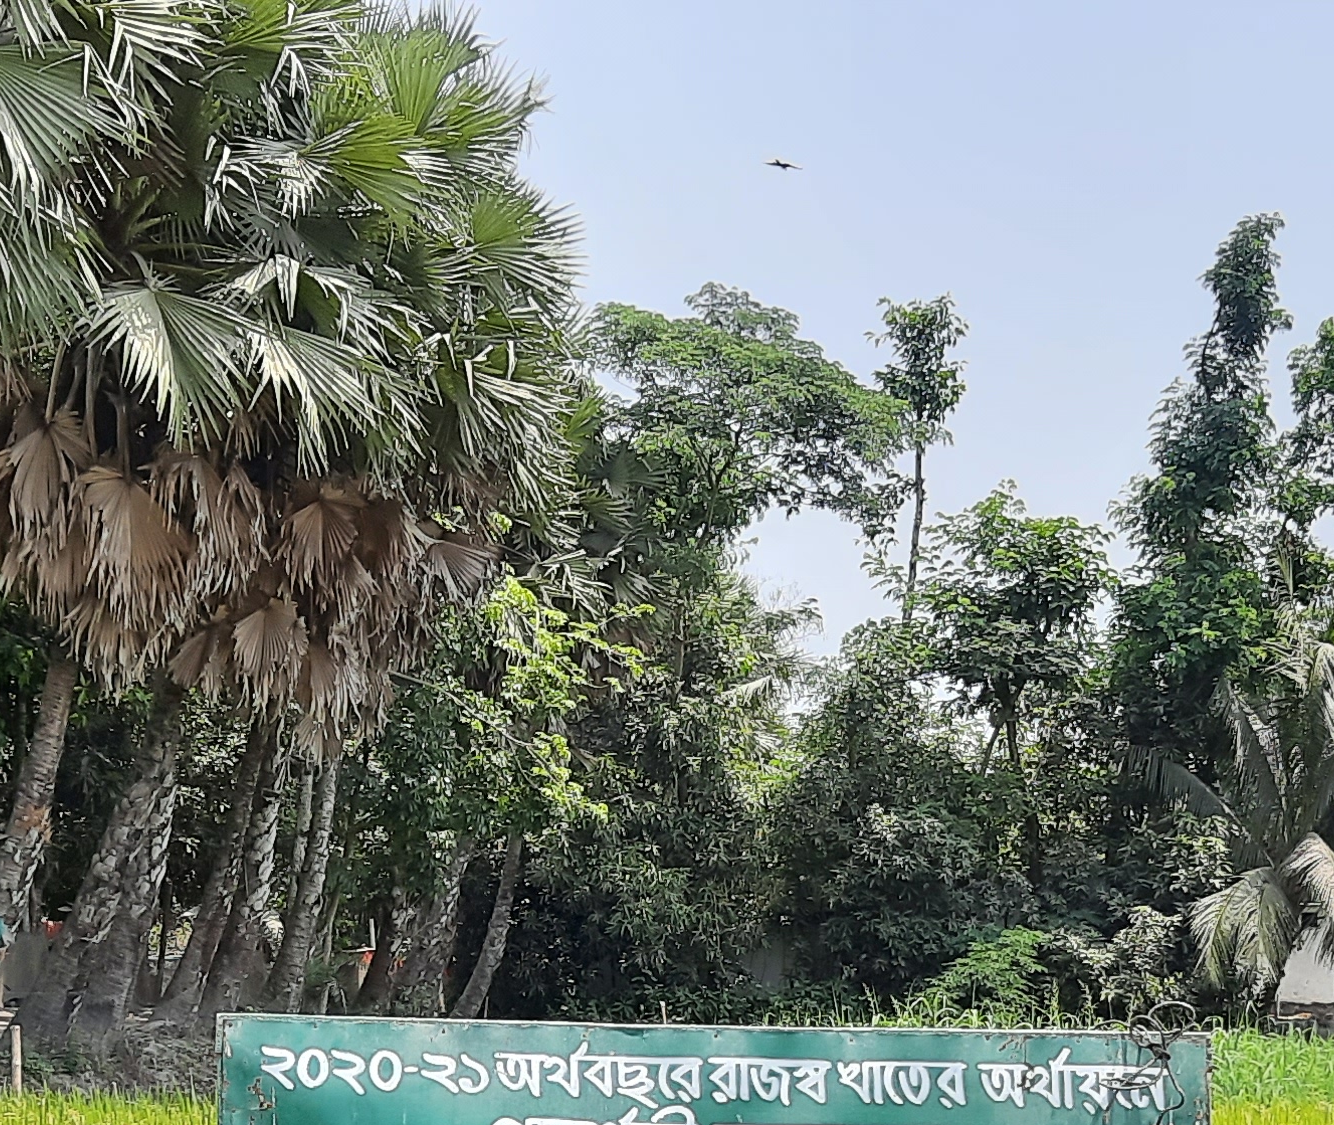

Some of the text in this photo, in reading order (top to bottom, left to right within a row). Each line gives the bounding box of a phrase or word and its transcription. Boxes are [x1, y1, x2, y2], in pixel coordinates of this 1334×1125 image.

[261, 1045, 489, 1095] ২০২০-২১
[494, 1041, 703, 1107] অর্থবছরে
[707, 1057, 832, 1106] রাজস্ব
[837, 1061, 967, 1109] খাতের
